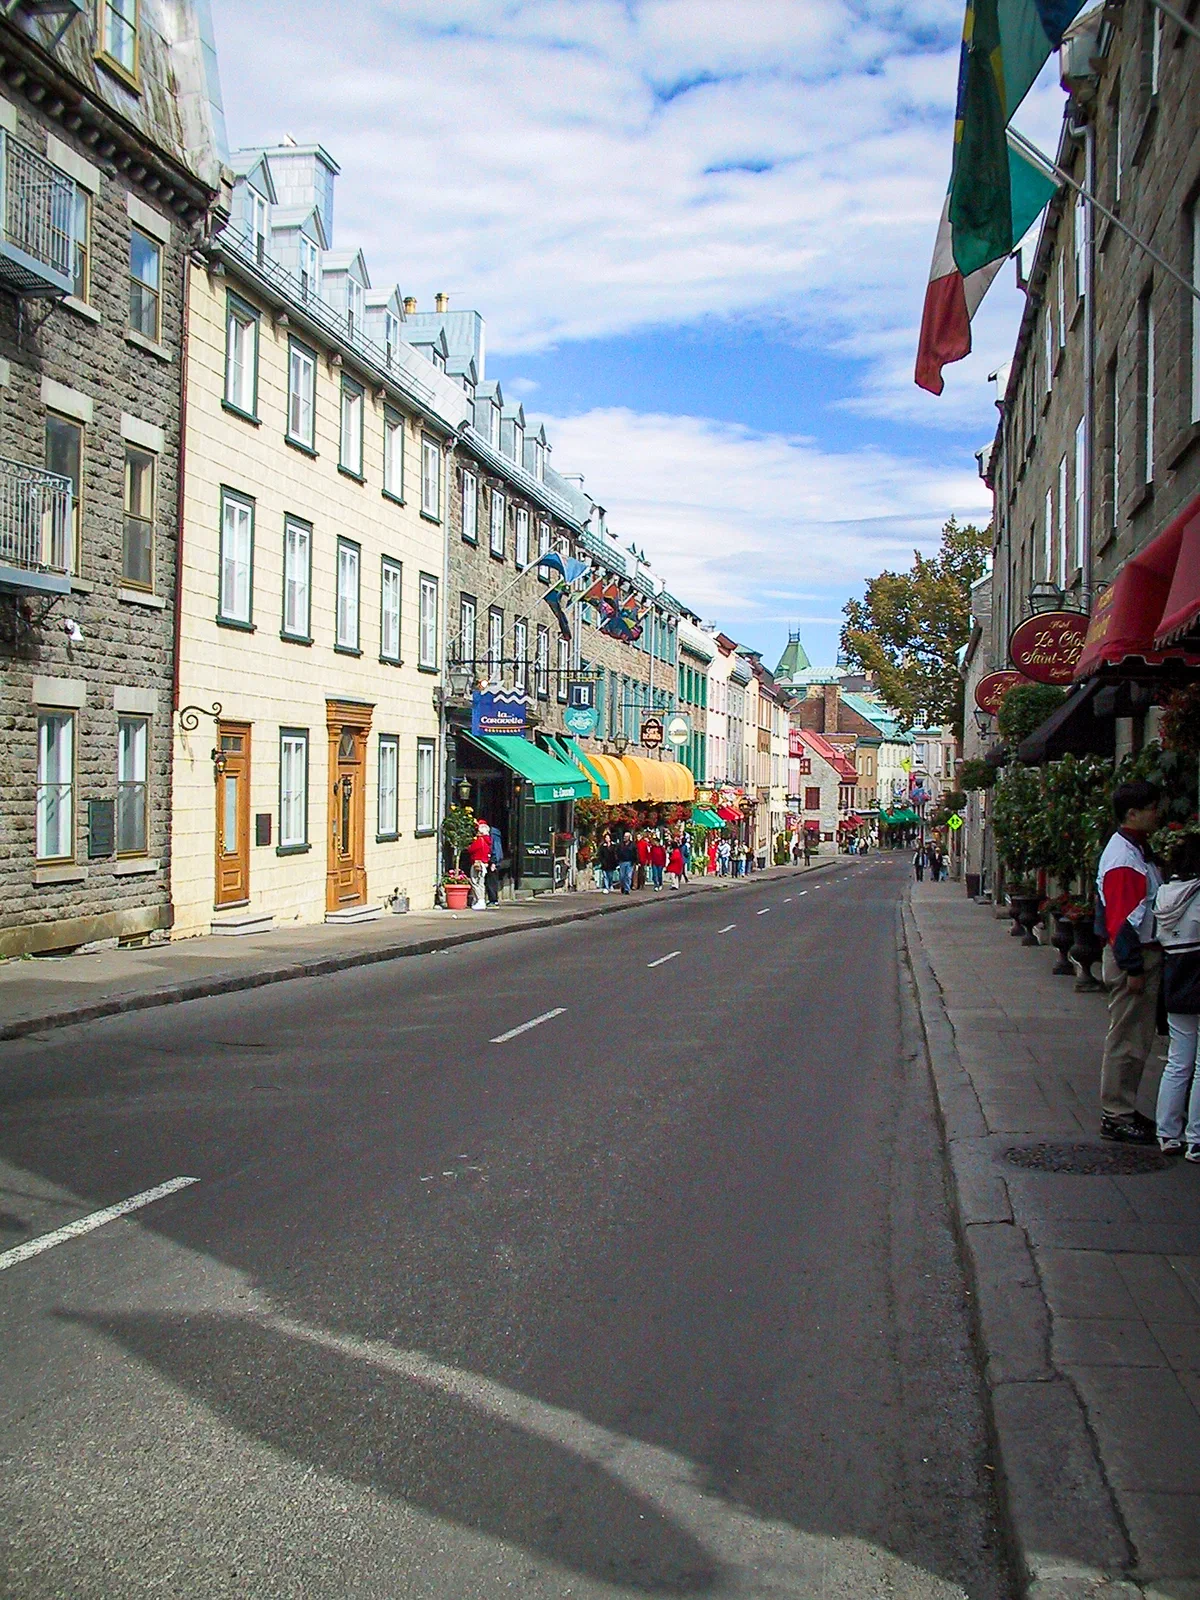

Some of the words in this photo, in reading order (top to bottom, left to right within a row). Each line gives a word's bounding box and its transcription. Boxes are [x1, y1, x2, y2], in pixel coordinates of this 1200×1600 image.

[1034, 630, 1054, 648] Le
[1021, 647, 1081, 665] Saint-Lo
[480, 716, 524, 725] Caravelle
